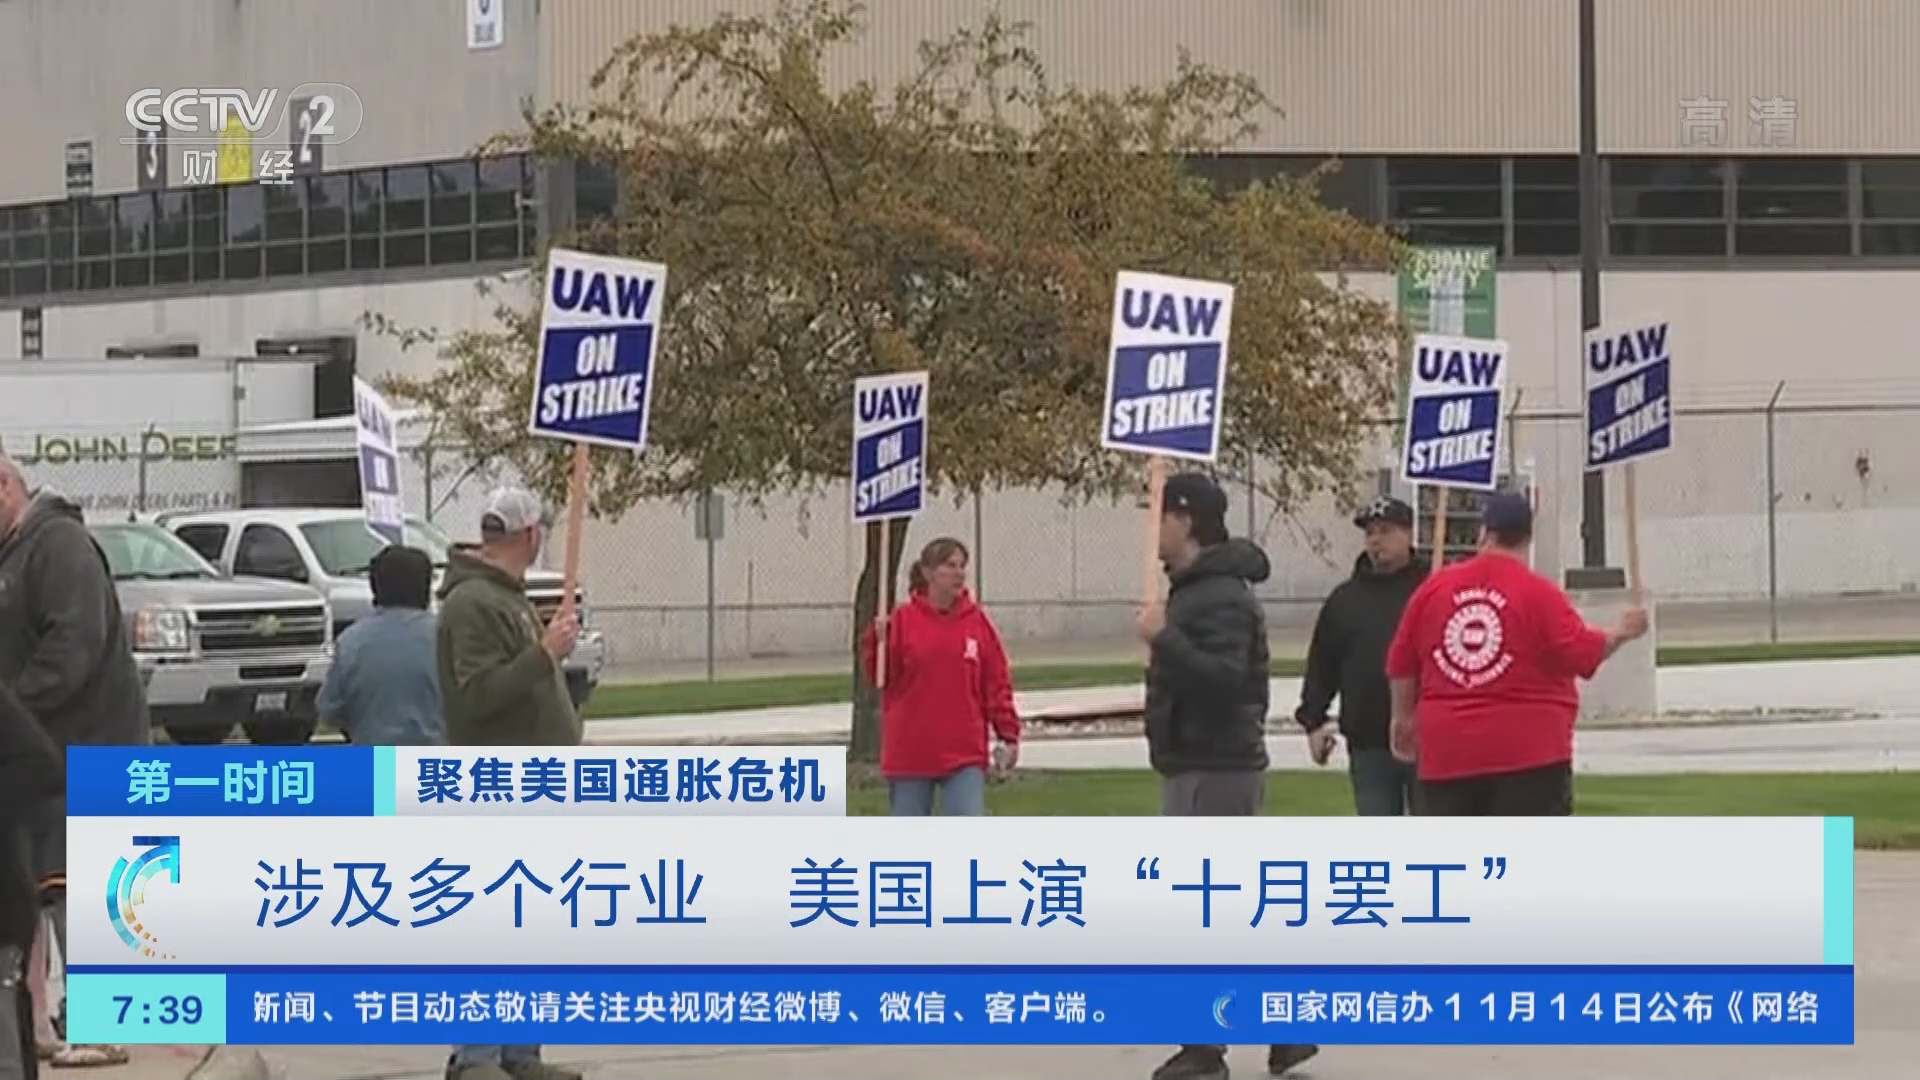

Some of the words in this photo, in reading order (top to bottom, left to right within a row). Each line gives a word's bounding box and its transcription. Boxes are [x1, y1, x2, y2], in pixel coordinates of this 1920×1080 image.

[552, 266, 655, 320] UAW
[1122, 288, 1222, 337] UAW
[576, 333, 617, 376] ON
[1419, 347, 1502, 386] UAW
[1590, 322, 1667, 372] UAW
[1147, 350, 1186, 391] ON
[540, 373, 643, 425] STRIKE
[860, 384, 923, 422] UAW
[1112, 388, 1213, 439] STRIKE
[1438, 398, 1473, 434] ON
[1615, 373, 1645, 416] ON
[22, 433, 128, 464] JOHN
[877, 430, 902, 469] ON
[1591, 395, 1669, 461] STRIKE
[1410, 429, 1493, 474] STRIKE
[858, 455, 921, 513] STRIKE
